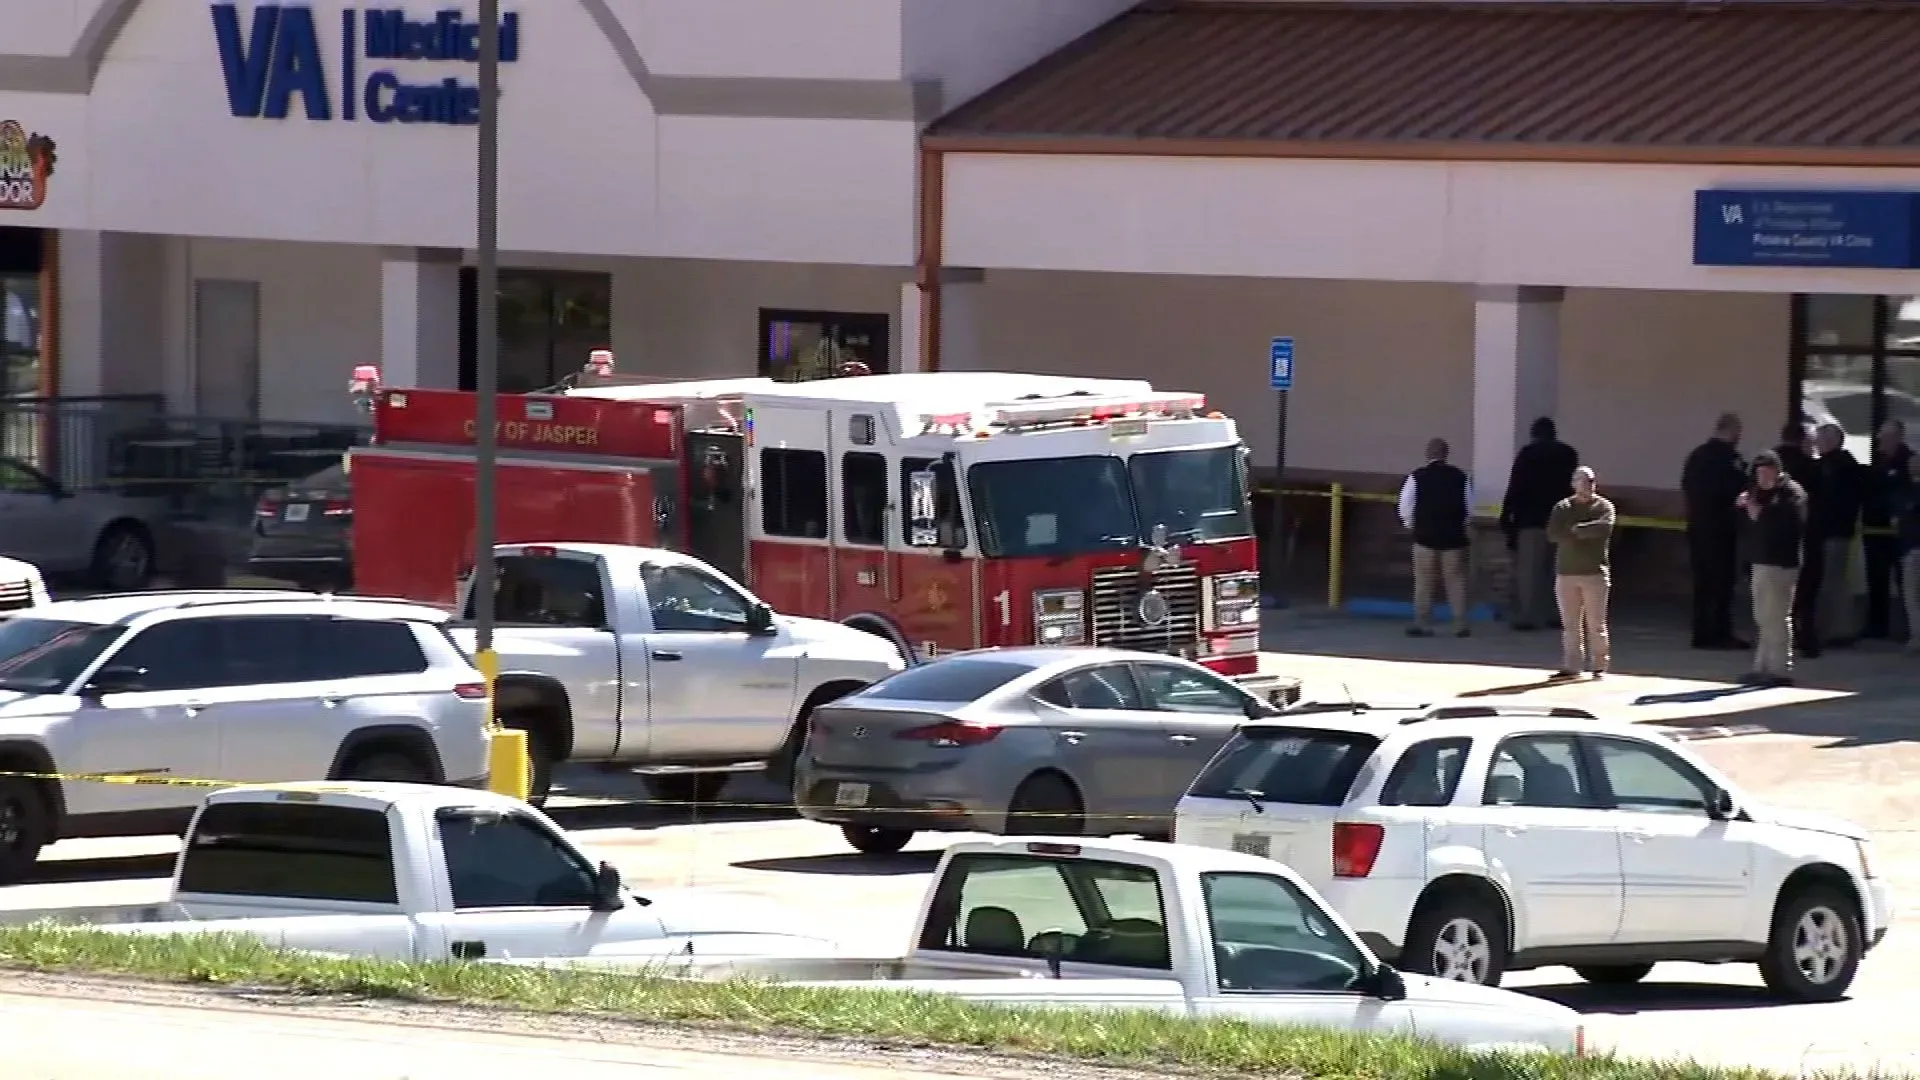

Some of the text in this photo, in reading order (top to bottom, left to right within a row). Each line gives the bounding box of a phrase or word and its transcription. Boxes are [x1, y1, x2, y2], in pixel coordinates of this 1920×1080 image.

[210, 4, 332, 121] VA
[364, 69, 502, 125] Cente
[1722, 204, 1743, 225] VA
[505, 421, 529, 441] OF
[533, 423, 599, 445] JASPER
[993, 590, 1011, 626] 1
